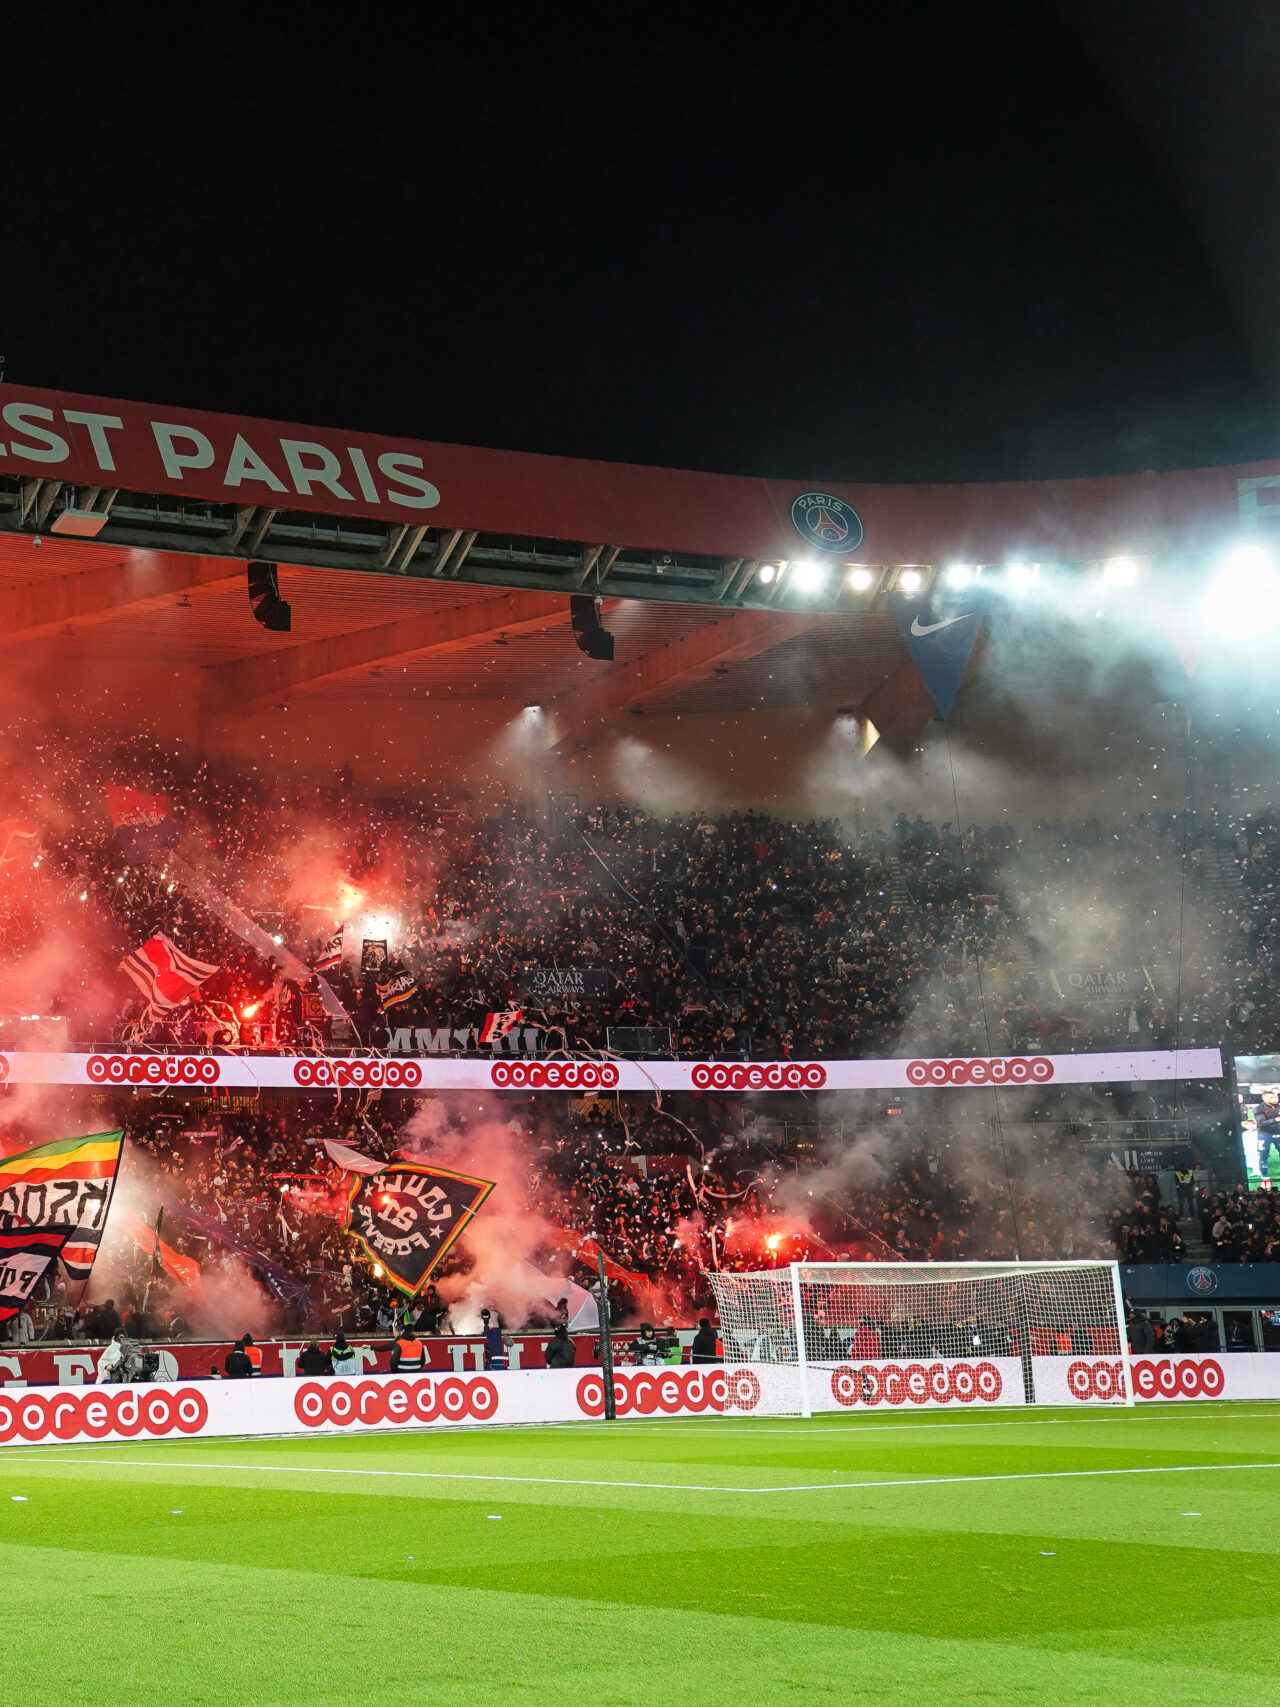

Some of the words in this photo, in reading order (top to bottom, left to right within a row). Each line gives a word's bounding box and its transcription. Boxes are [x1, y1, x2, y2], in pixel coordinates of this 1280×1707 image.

[150, 420, 442, 510] PARIS
[798, 496, 843, 512] PARIS
[535, 971, 584, 987] QATAR
[547, 985, 585, 994] AIRWAYS
[1068, 971, 1128, 988] QATAR
[1084, 984, 1129, 993] AIRWAYS
[91, 1056, 215, 1080] ooredoo
[298, 1059, 418, 1084] ooredoo
[496, 1062, 614, 1085] ooredoo
[696, 1063, 822, 1085] ooredoo
[911, 1058, 1048, 1081] ooredoo
[837, 1365, 996, 1397] ooredoo
[1073, 1360, 1219, 1392] ooredoo
[302, 1379, 491, 1421] ooredoo
[583, 1372, 754, 1408] ooredoo
